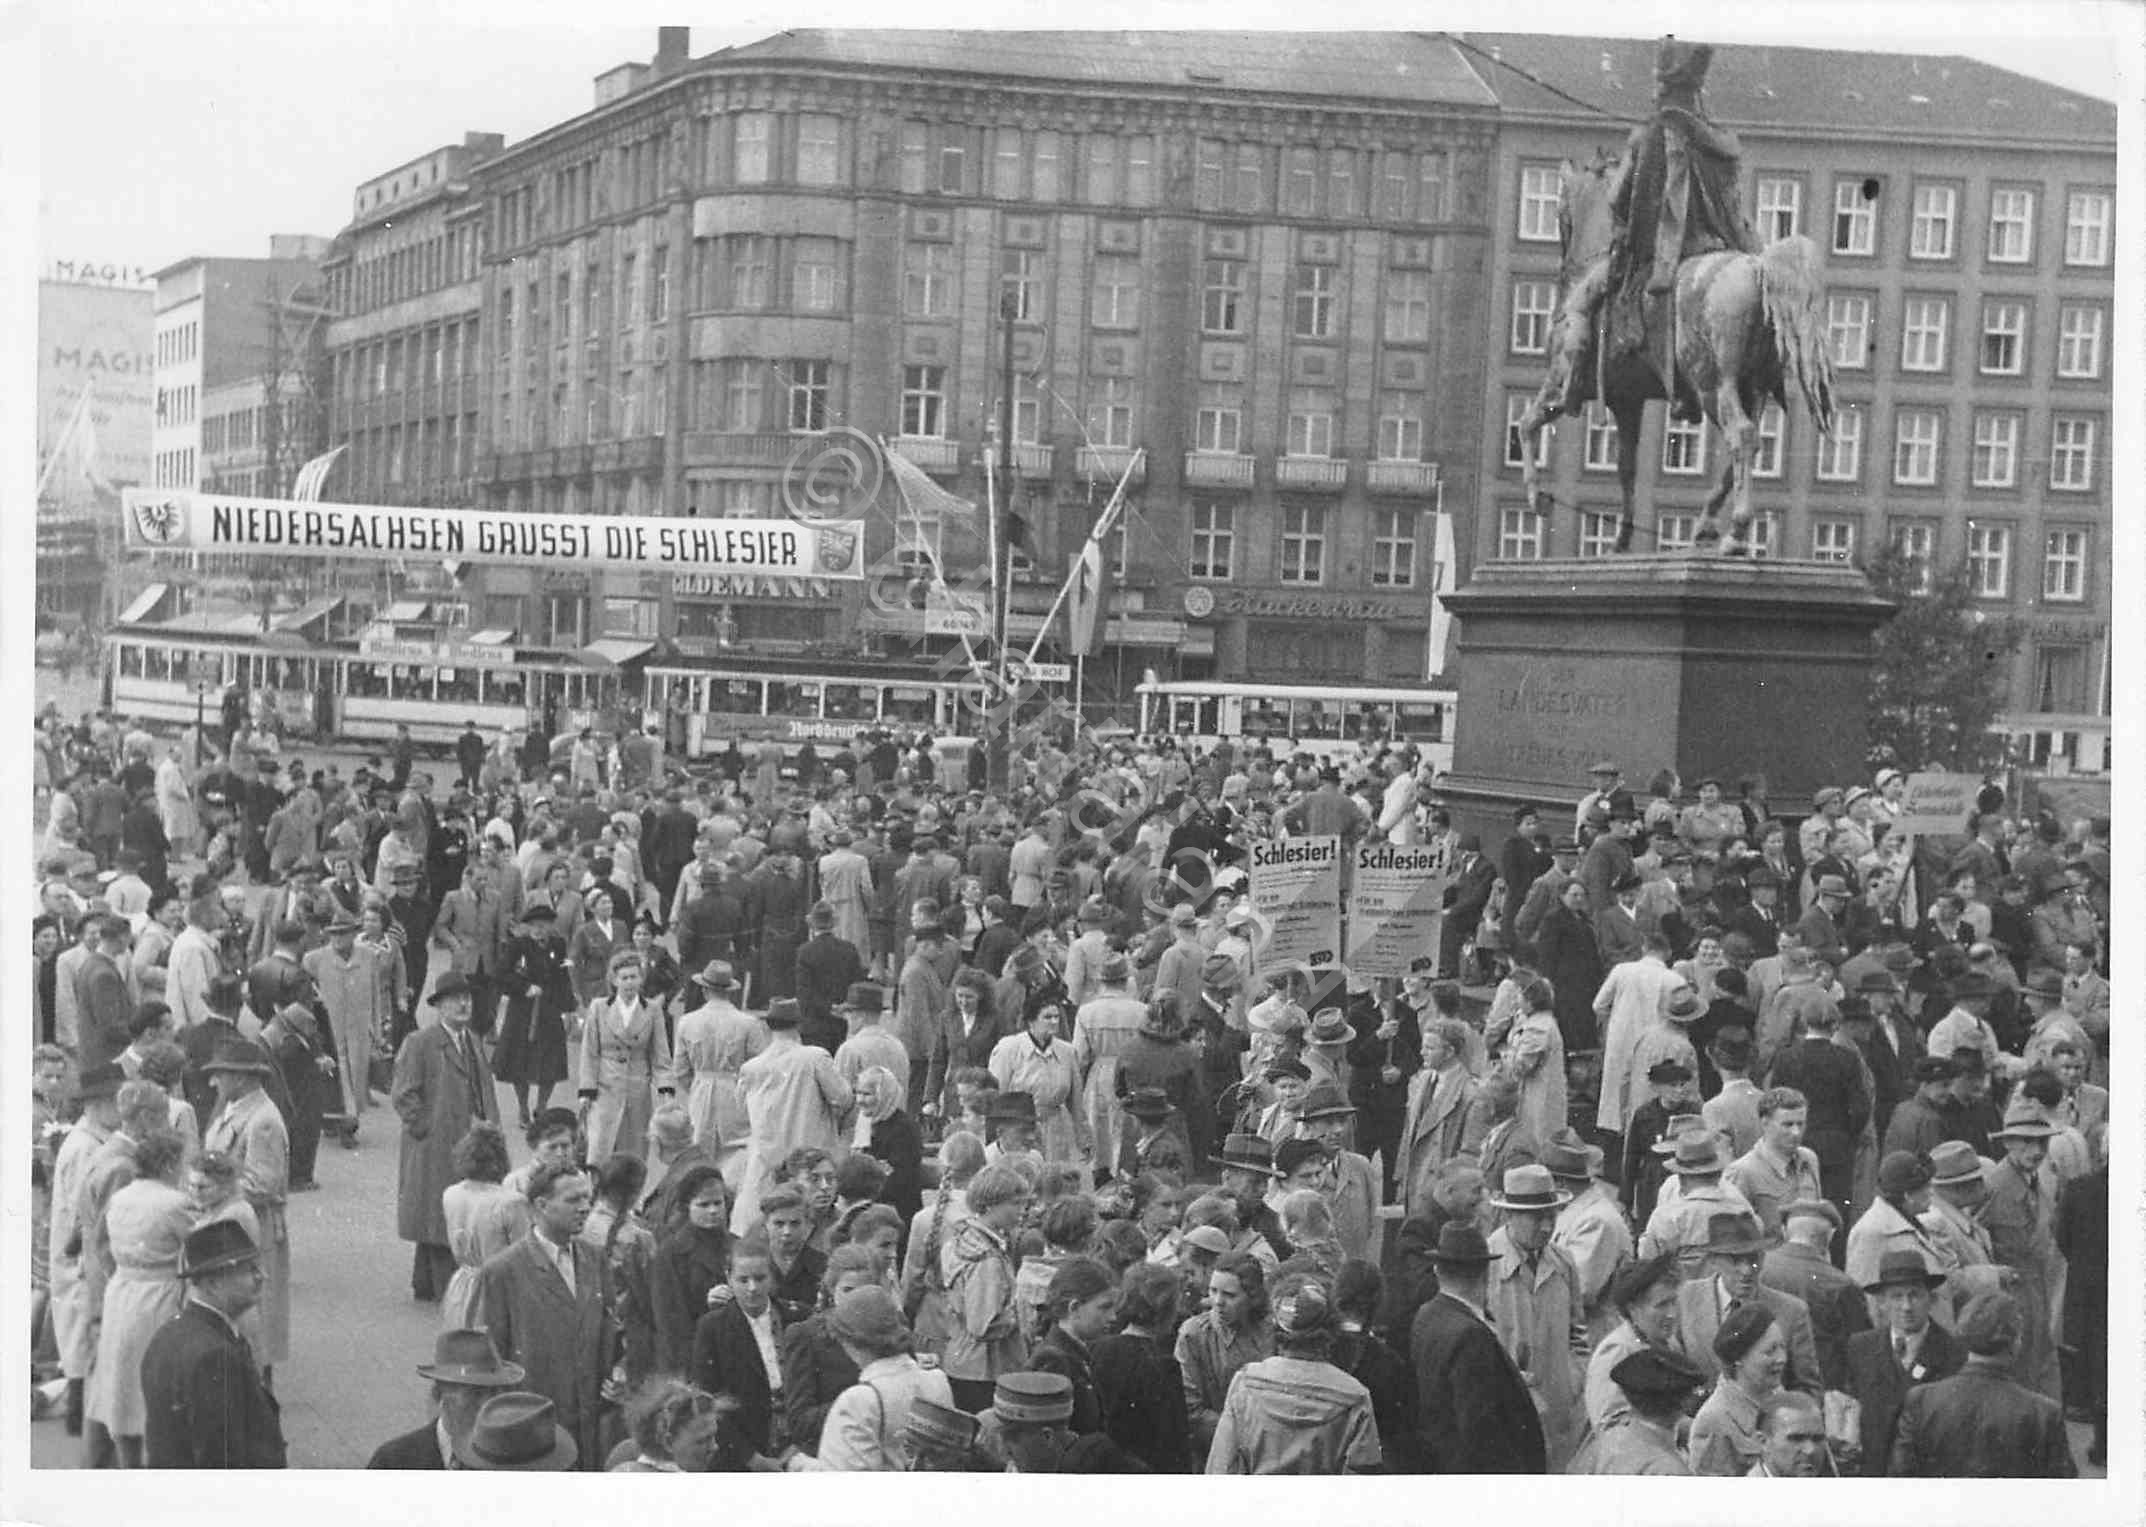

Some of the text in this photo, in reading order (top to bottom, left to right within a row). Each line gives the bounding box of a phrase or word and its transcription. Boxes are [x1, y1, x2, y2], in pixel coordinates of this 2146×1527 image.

[213, 505, 798, 565] NIEDERSACHSEN GRUSST DIE SCHLESIER
[1253, 839, 1336, 867] Schlesier!
[1359, 846, 1445, 870] Schlesier!
